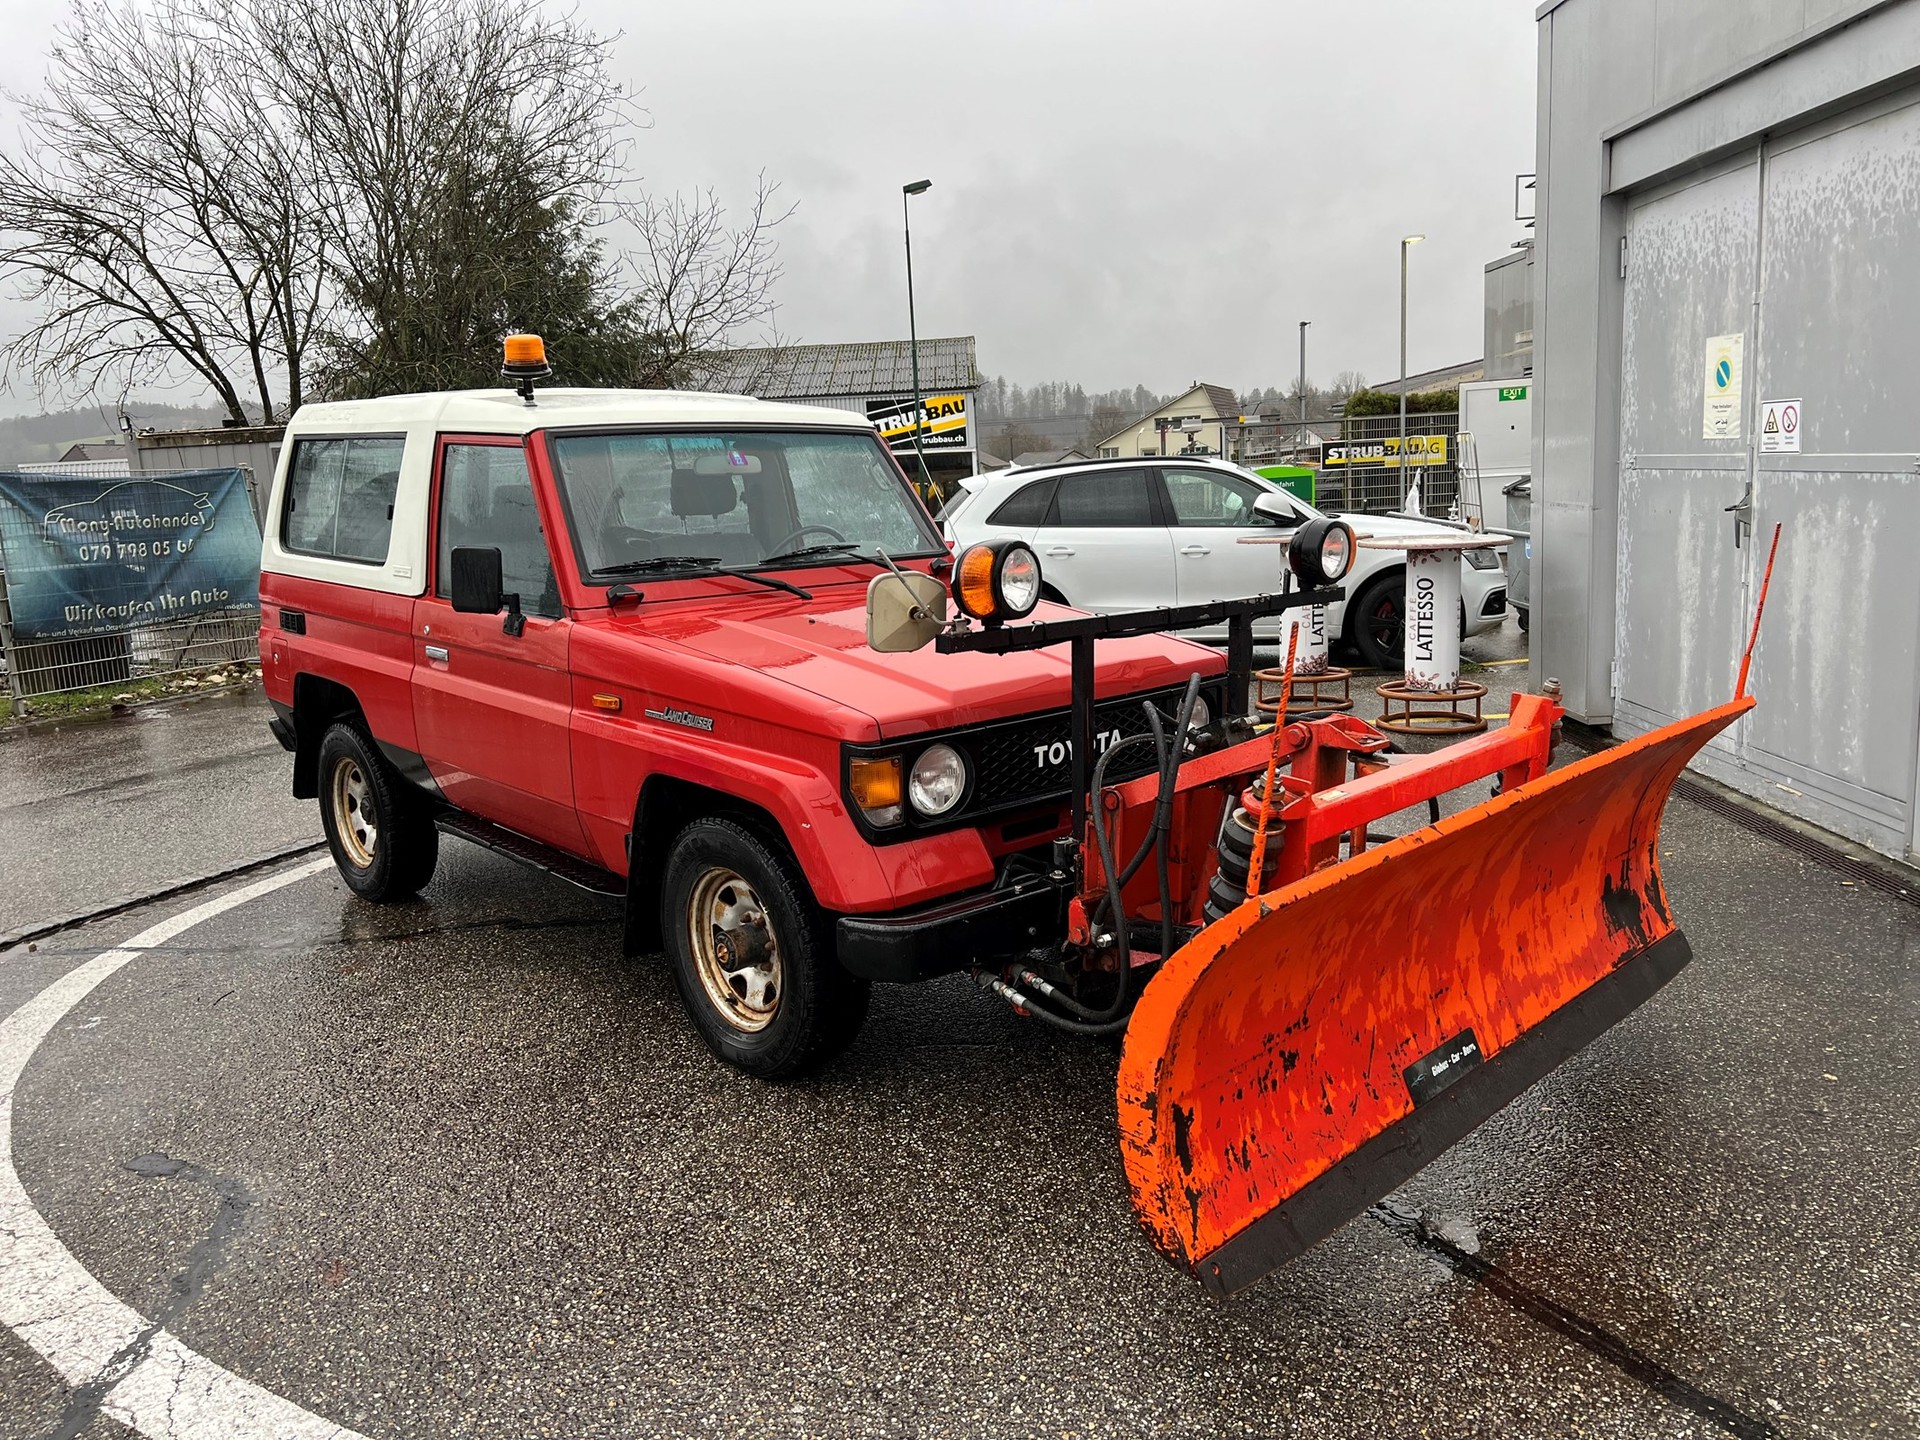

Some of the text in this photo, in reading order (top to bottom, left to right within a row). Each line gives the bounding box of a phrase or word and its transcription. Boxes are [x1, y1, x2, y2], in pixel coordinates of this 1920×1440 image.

[1503, 388, 1522, 396] EXIT
[873, 400, 965, 432] TRUBBAU
[1768, 421, 1774, 430] EX
[921, 435, 964, 445] trubbau.ch
[60, 511, 206, 536] Mony-Autohandel
[79, 545, 111, 561] 079
[117, 542, 148, 559] 798
[152, 541, 170, 556] 05
[159, 593, 185, 610] Ihr
[191, 586, 228, 606] Auto
[1302, 606, 1311, 628] CAF
[1311, 603, 1324, 646] LATTE
[1416, 578, 1434, 661] LATTESSO
[52, 629, 66, 637] und
[1034, 729, 1121, 768] TOYTA
